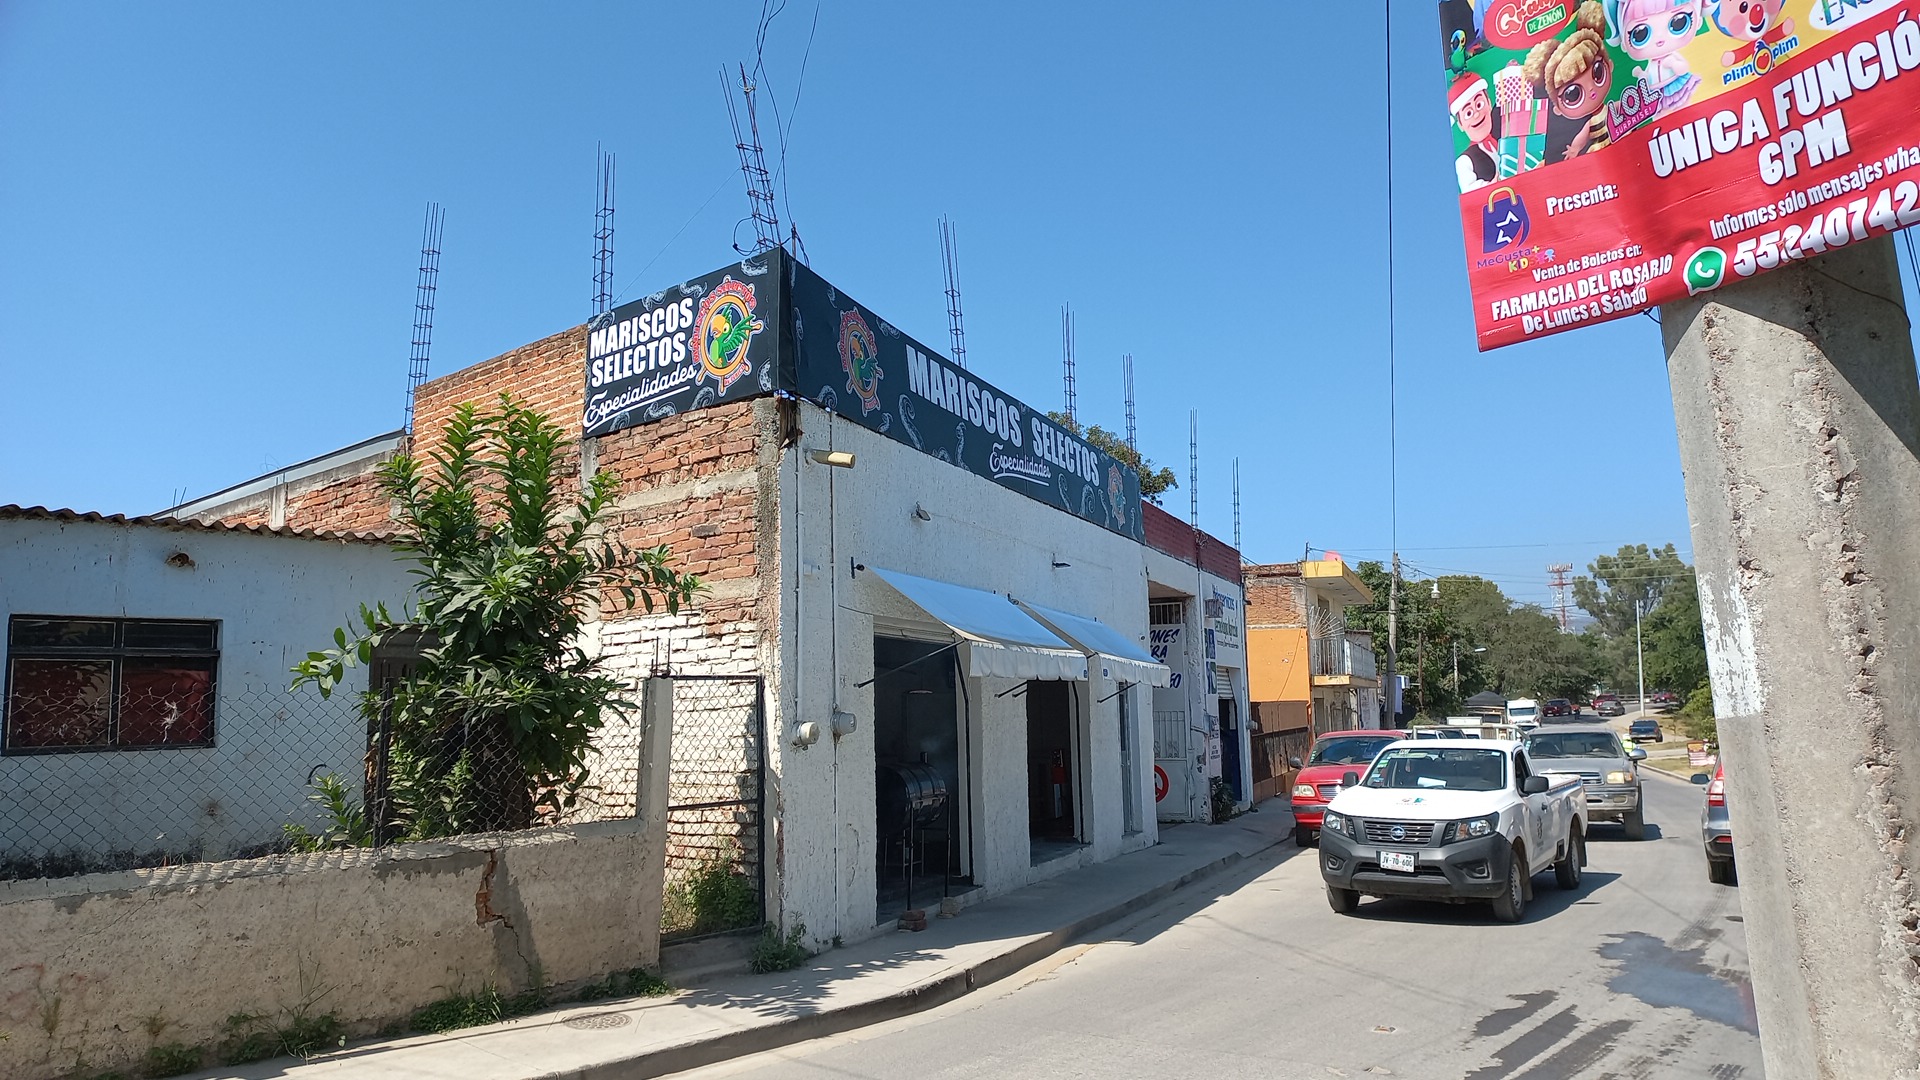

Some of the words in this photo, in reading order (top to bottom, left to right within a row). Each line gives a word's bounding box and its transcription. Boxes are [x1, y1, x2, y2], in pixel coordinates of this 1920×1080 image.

[1528, 21, 1537, 32] DE
[1722, 63, 1753, 84] plim
[1772, 36, 1798, 59] plim
[1615, 106, 1652, 137] SURPRISE!
[1648, 98, 1770, 178] ÚNICA
[1772, 9, 1920, 130] FUNCIÓ
[1758, 108, 1851, 186] 6PM
[1546, 184, 1619, 216] Presenta:
[1709, 202, 1777, 241] Informes
[1778, 190, 1807, 218] sólo
[1810, 163, 1883, 206] mensajes
[1884, 146, 1920, 175] wha
[1733, 180, 1920, 278] 55240742
[1491, 282, 1578, 322] FARMACIA
[1577, 272, 1609, 299] DEL
[1610, 253, 1674, 290] ROSARIO
[1532, 262, 1566, 283] Venta
[1566, 258, 1581, 276] de
[1582, 247, 1624, 271] Boletos
[1626, 244, 1643, 260] en:
[589, 297, 694, 360] MARISCOS
[1521, 312, 1544, 335] De
[1544, 304, 1589, 331] Lunes
[1590, 305, 1601, 318] a
[591, 332, 686, 388] SELECTOS
[583, 363, 697, 428] Especialidades
[905, 343, 1023, 448] MARISCOS
[1031, 416, 1100, 488] SELECTOS
[988, 442, 1051, 480] Especialidades
